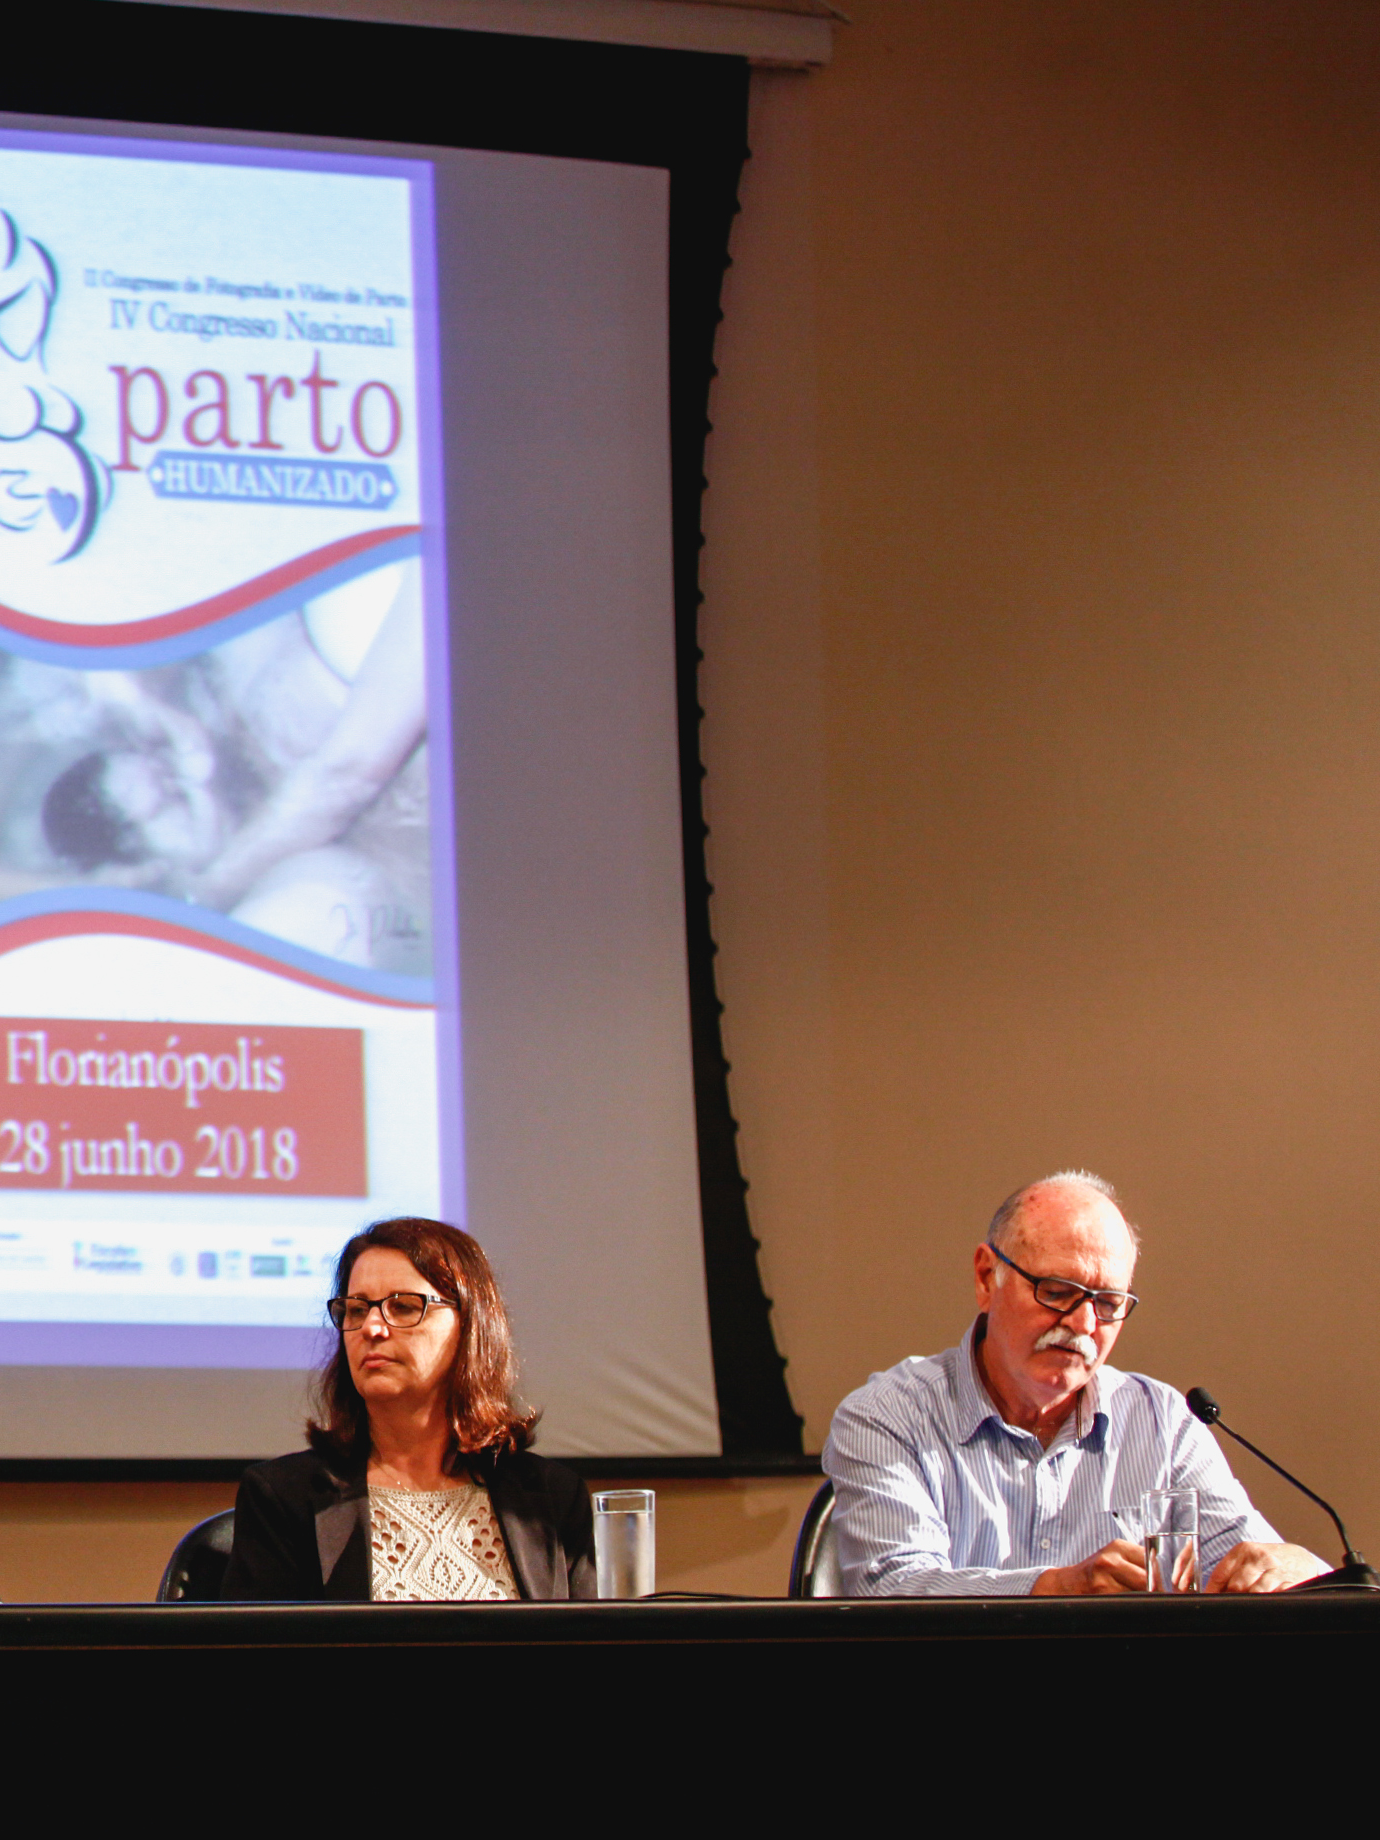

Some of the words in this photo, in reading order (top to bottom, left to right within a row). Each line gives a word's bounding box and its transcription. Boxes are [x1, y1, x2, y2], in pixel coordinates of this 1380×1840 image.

[110, 298, 140, 330] IV
[148, 300, 277, 342] Congresso
[284, 310, 395, 347] Nacional
[108, 348, 402, 472] parto
[163, 458, 379, 503] HUMANIZADO
[7, 1031, 285, 1108] Florianópolis
[60, 1122, 182, 1186] junho
[195, 1125, 299, 1181] 2018
